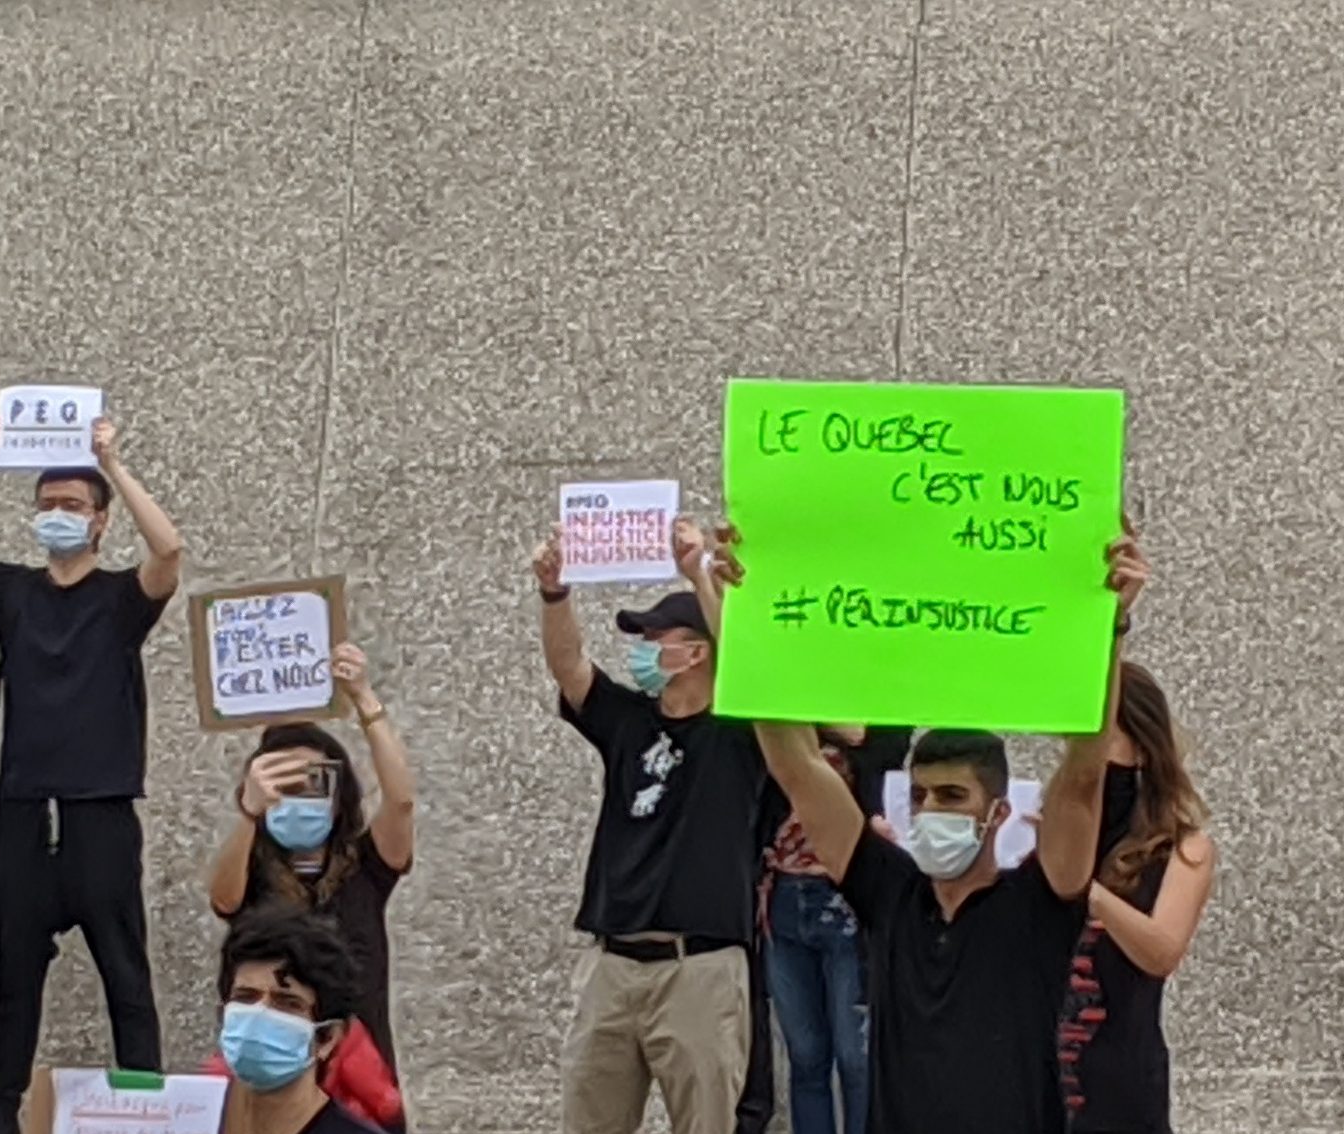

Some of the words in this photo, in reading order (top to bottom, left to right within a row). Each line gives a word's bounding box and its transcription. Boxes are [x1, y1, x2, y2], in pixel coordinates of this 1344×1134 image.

[10, 399, 78, 424] PEQ
[757, 409, 810, 456] LE
[822, 412, 964, 456] QUEBEC
[891, 462, 983, 504] C'EST
[1003, 472, 1081, 511] NOUS
[566, 508, 667, 527] INJUSTICE
[566, 527, 667, 545] INJUSTICE
[566, 546, 668, 564] INJUSTICE
